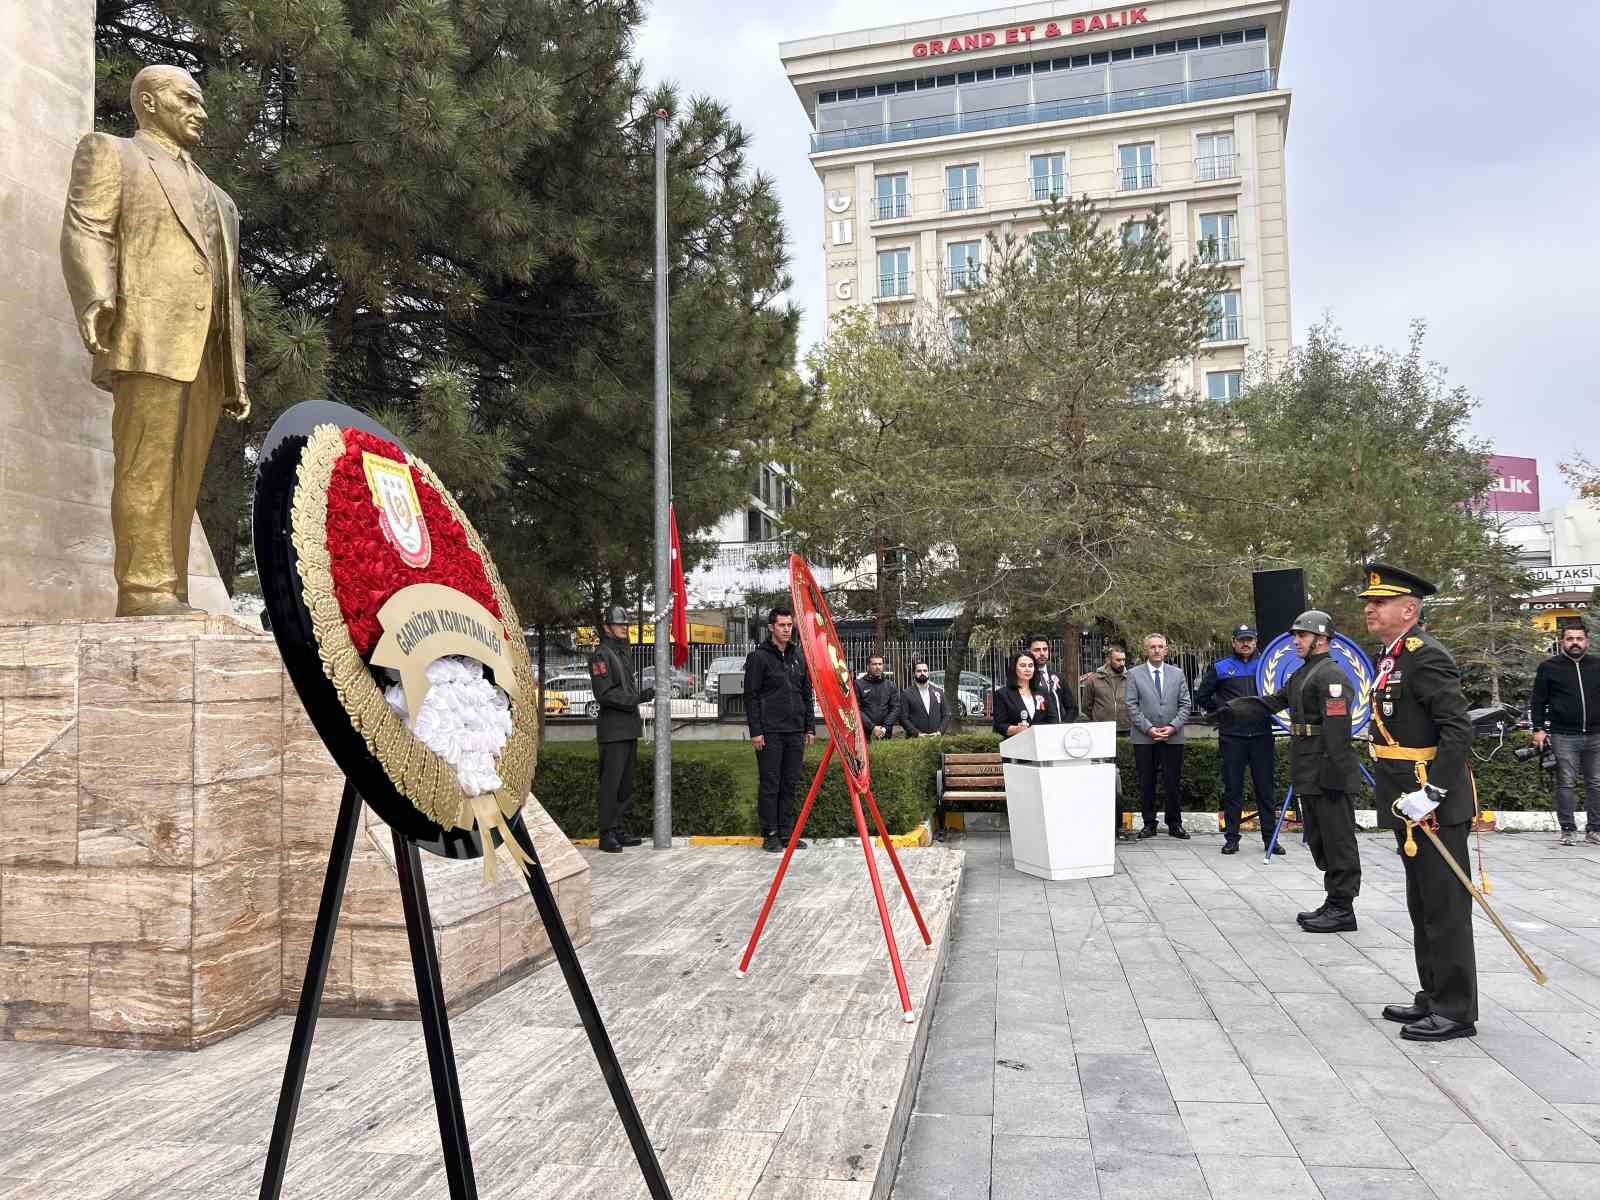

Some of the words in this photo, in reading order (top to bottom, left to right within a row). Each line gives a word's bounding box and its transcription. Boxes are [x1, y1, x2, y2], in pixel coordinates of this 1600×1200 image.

[912, 32, 996, 58] GRAND
[1005, 25, 1035, 45] ET
[1044, 22, 1062, 39] &
[1071, 7, 1149, 34] BALIK
[1555, 567, 1593, 580] TAKSİ
[396, 611, 440, 656] GARNİZON
[439, 609, 502, 657] KOMUTANLIĞI
